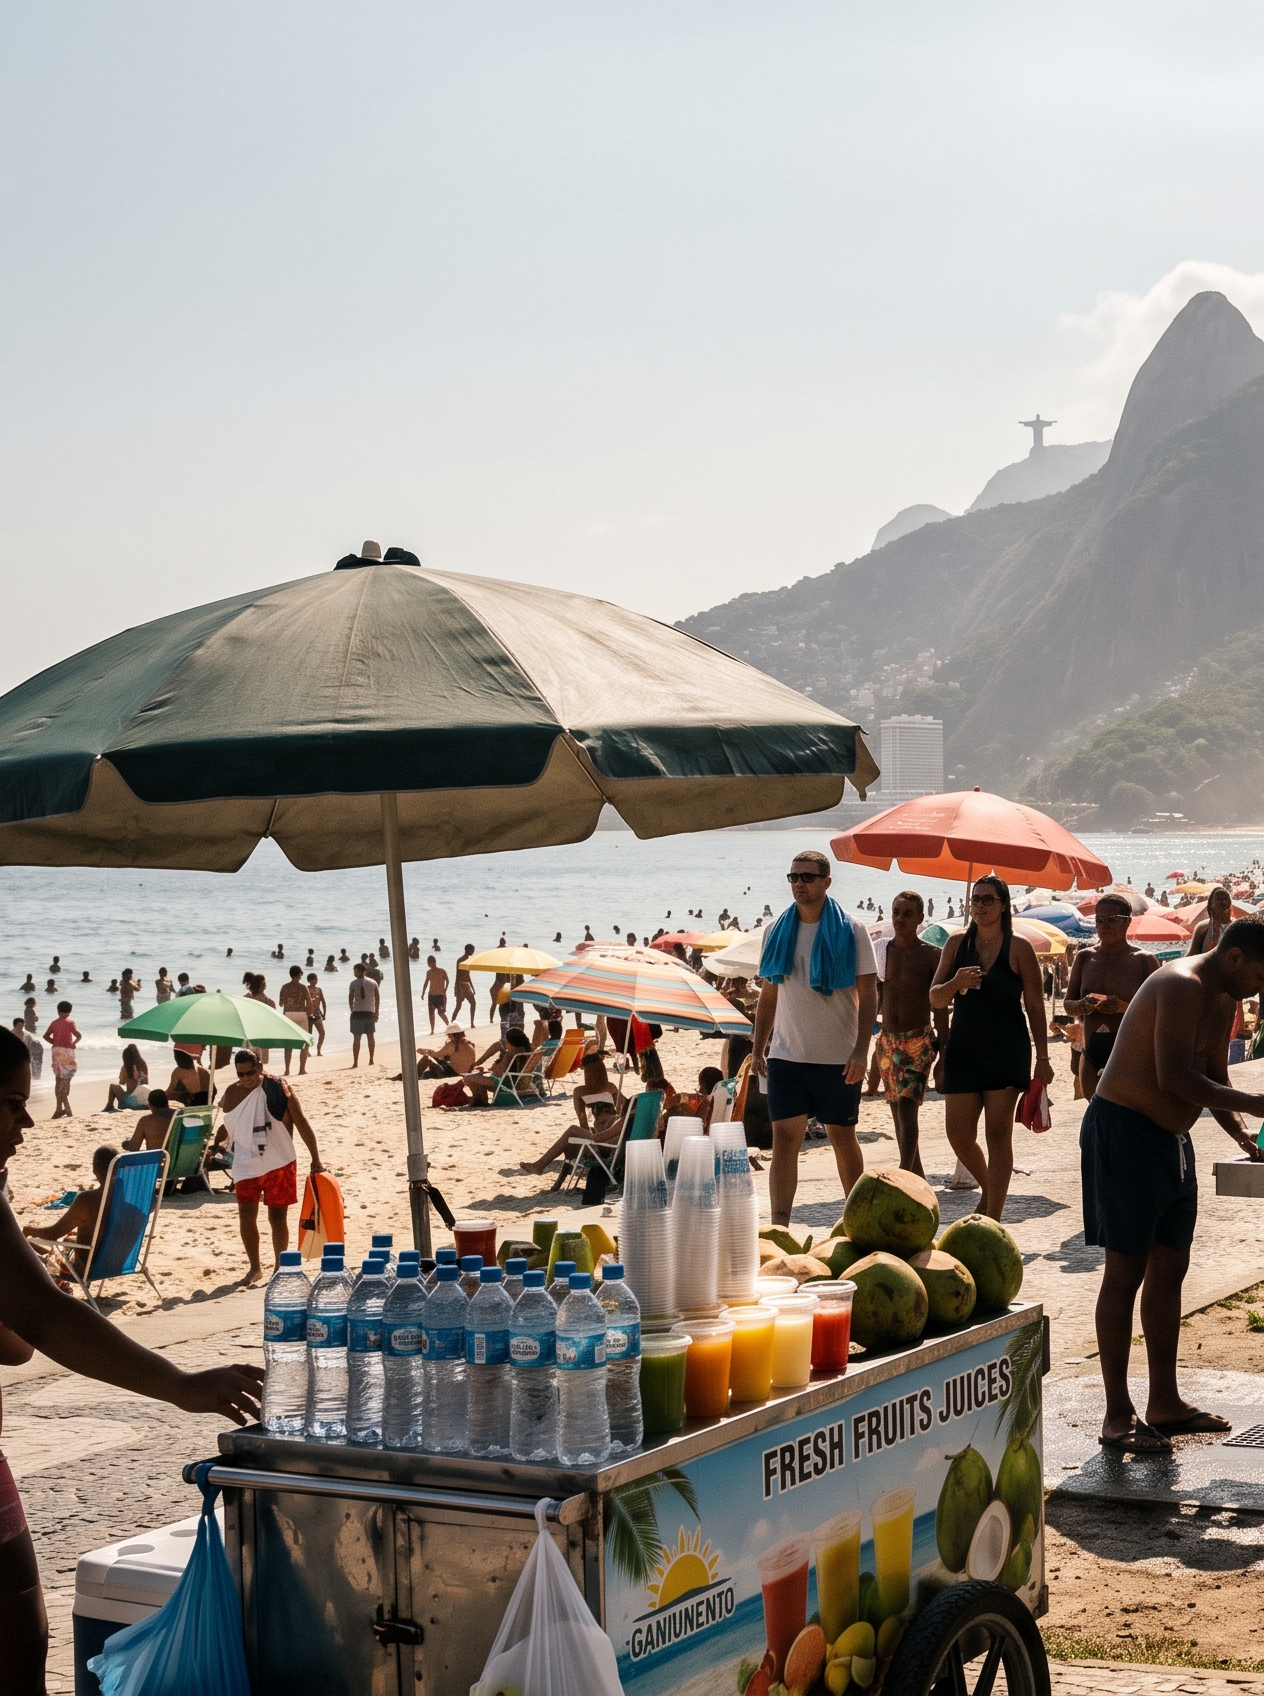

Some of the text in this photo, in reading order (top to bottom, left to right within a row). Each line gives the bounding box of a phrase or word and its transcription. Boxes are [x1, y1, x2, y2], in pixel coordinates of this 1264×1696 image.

[764, 1357, 1011, 1498] FRESH FRUITS JUICES
[631, 1586, 735, 1659] GANIUNENTO
